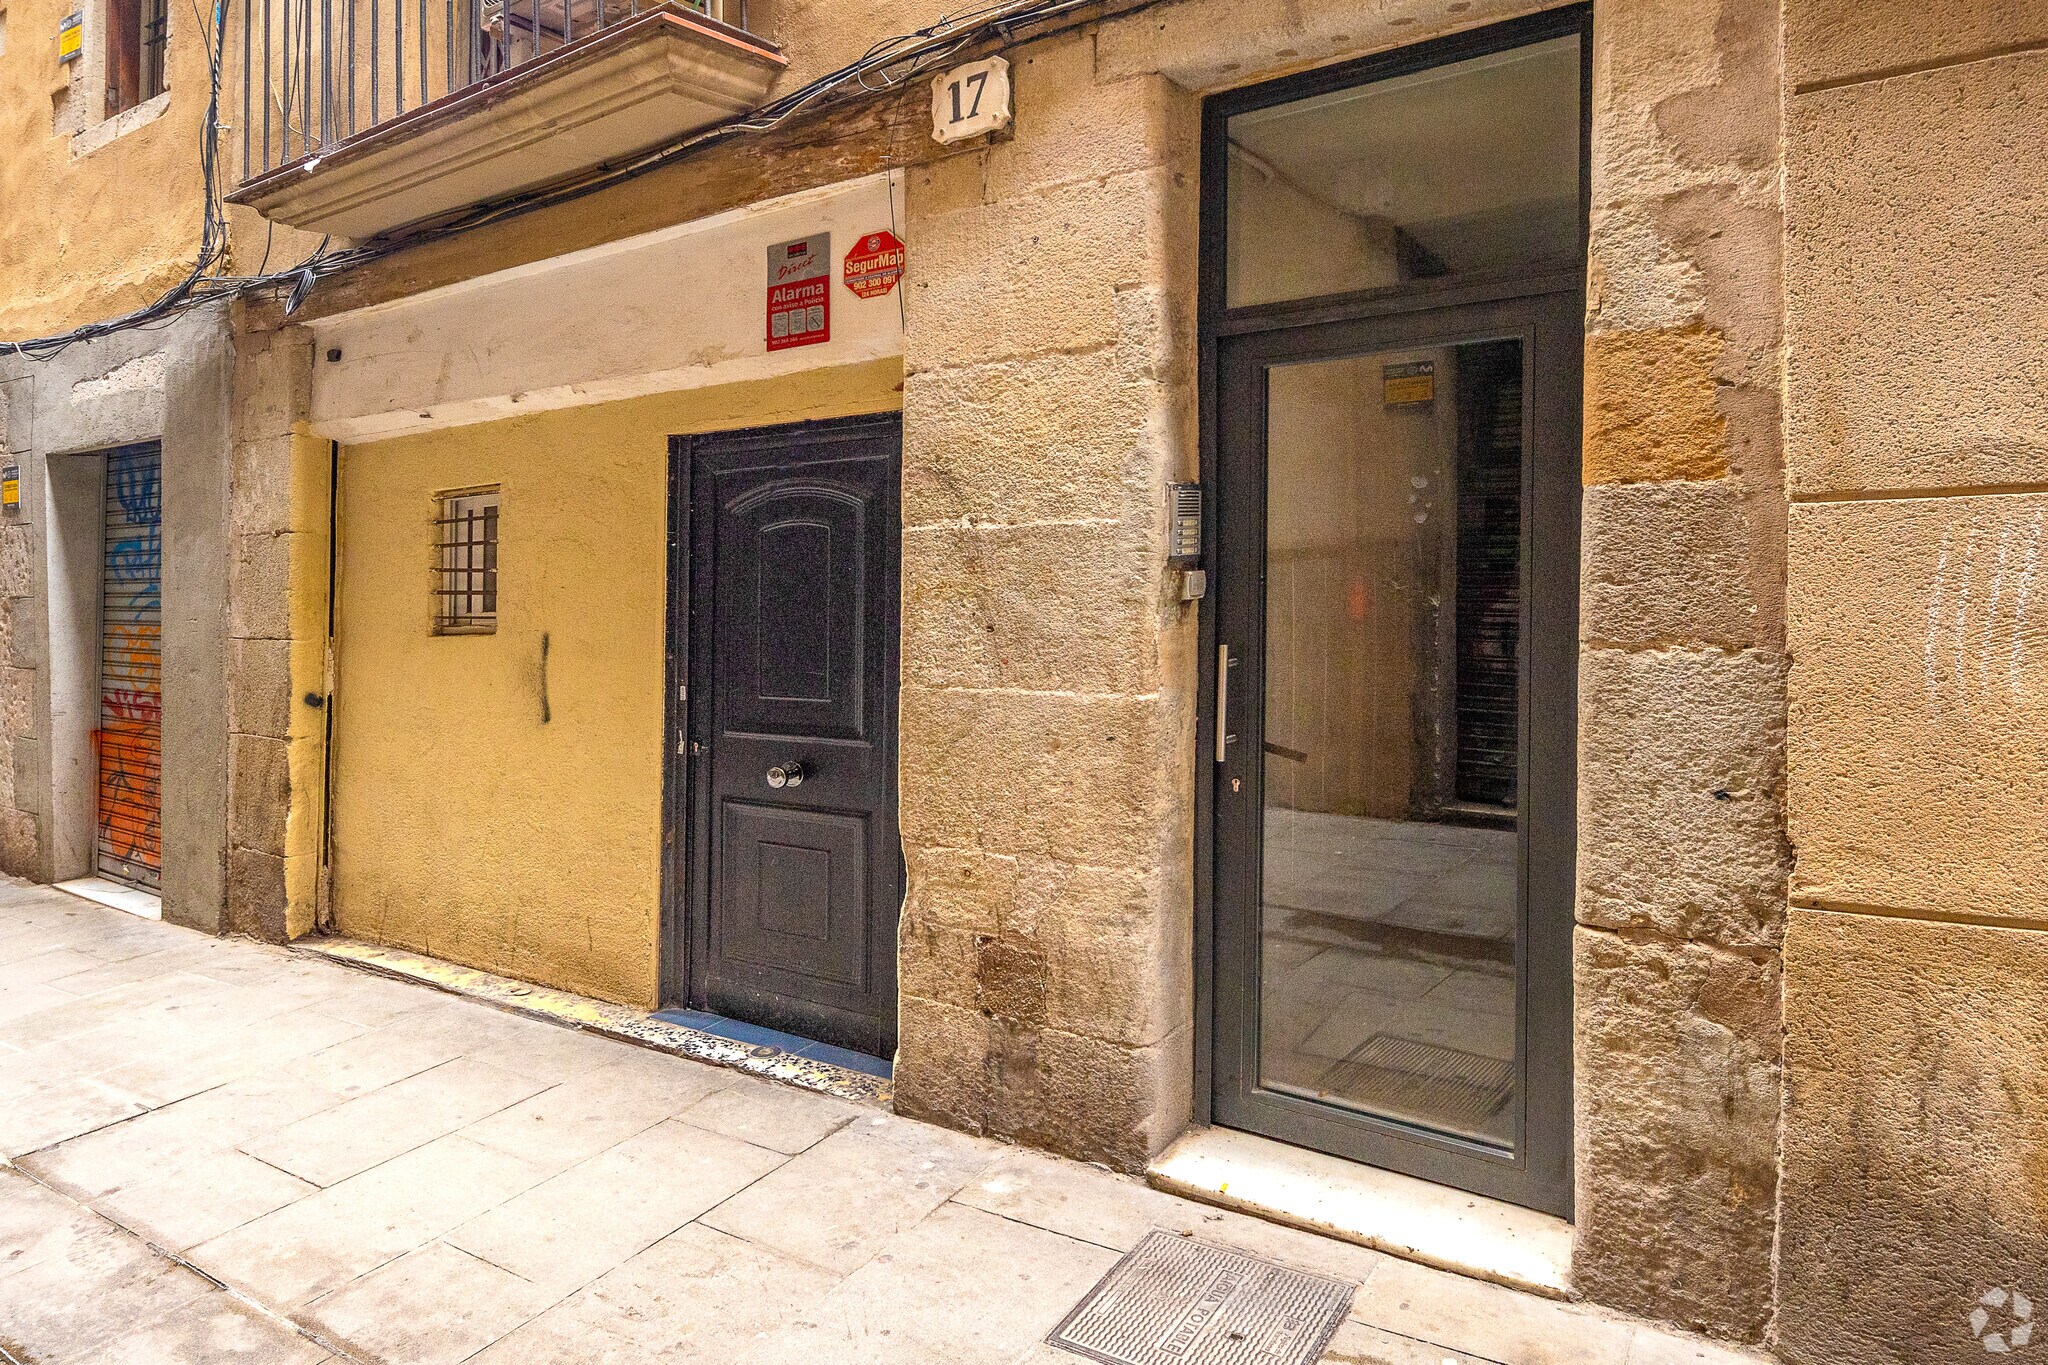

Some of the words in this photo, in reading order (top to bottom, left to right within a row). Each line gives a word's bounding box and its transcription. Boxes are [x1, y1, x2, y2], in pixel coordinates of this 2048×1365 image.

[947, 70, 989, 124] 17
[778, 253, 819, 280] Direct
[772, 283, 824, 304] Alarma
[853, 280, 867, 290] 902
[882, 275, 896, 285] 091
[782, 302, 799, 310] aviso
[1204, 1272, 1236, 1303] AIGUA
[1166, 1308, 1210, 1353] POTABLE
